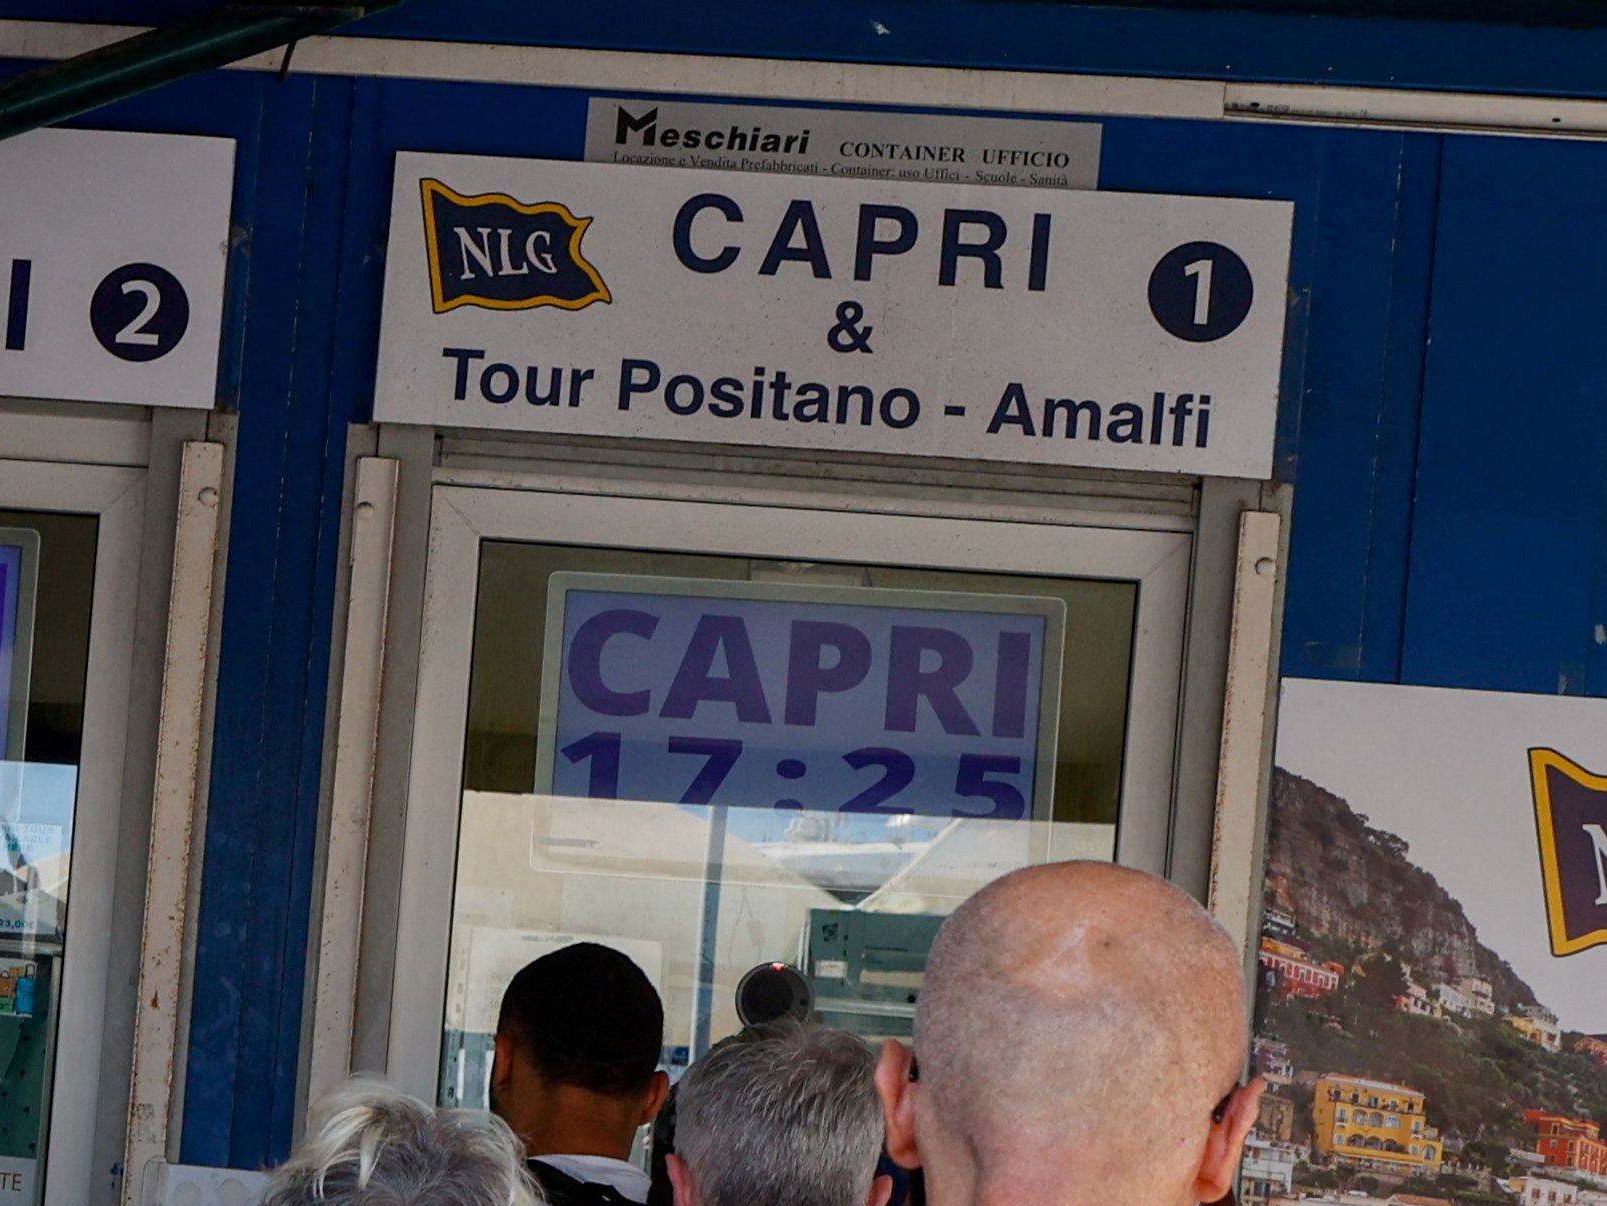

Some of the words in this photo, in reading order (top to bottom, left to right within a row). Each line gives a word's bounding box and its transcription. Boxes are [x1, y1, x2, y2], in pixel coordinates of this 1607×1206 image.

[615, 106, 811, 154] Meschiari
[840, 141, 965, 163] CONTAINER
[983, 149, 1070, 169] UFFICIO
[613, 151, 676, 167] Locazione
[690, 155, 736, 170] Vendita
[741, 158, 818, 174] Prefabbricati
[898, 168, 920, 178] uso
[924, 167, 960, 181] Uffici
[975, 170, 1017, 184] Scuole
[1029, 173, 1069, 186] Sanità
[453, 225, 559, 283] NLG
[672, 192, 1052, 293] CAPRI
[114, 278, 163, 347] 2
[1173, 258, 1216, 326] 1
[825, 300, 875, 355] &
[441, 348, 595, 407] Tour
[618, 358, 921, 430] Positano
[985, 381, 1211, 450] Amalfi
[566, 607, 1032, 738] CAPRI
[560, 731, 1025, 820] 17:25
